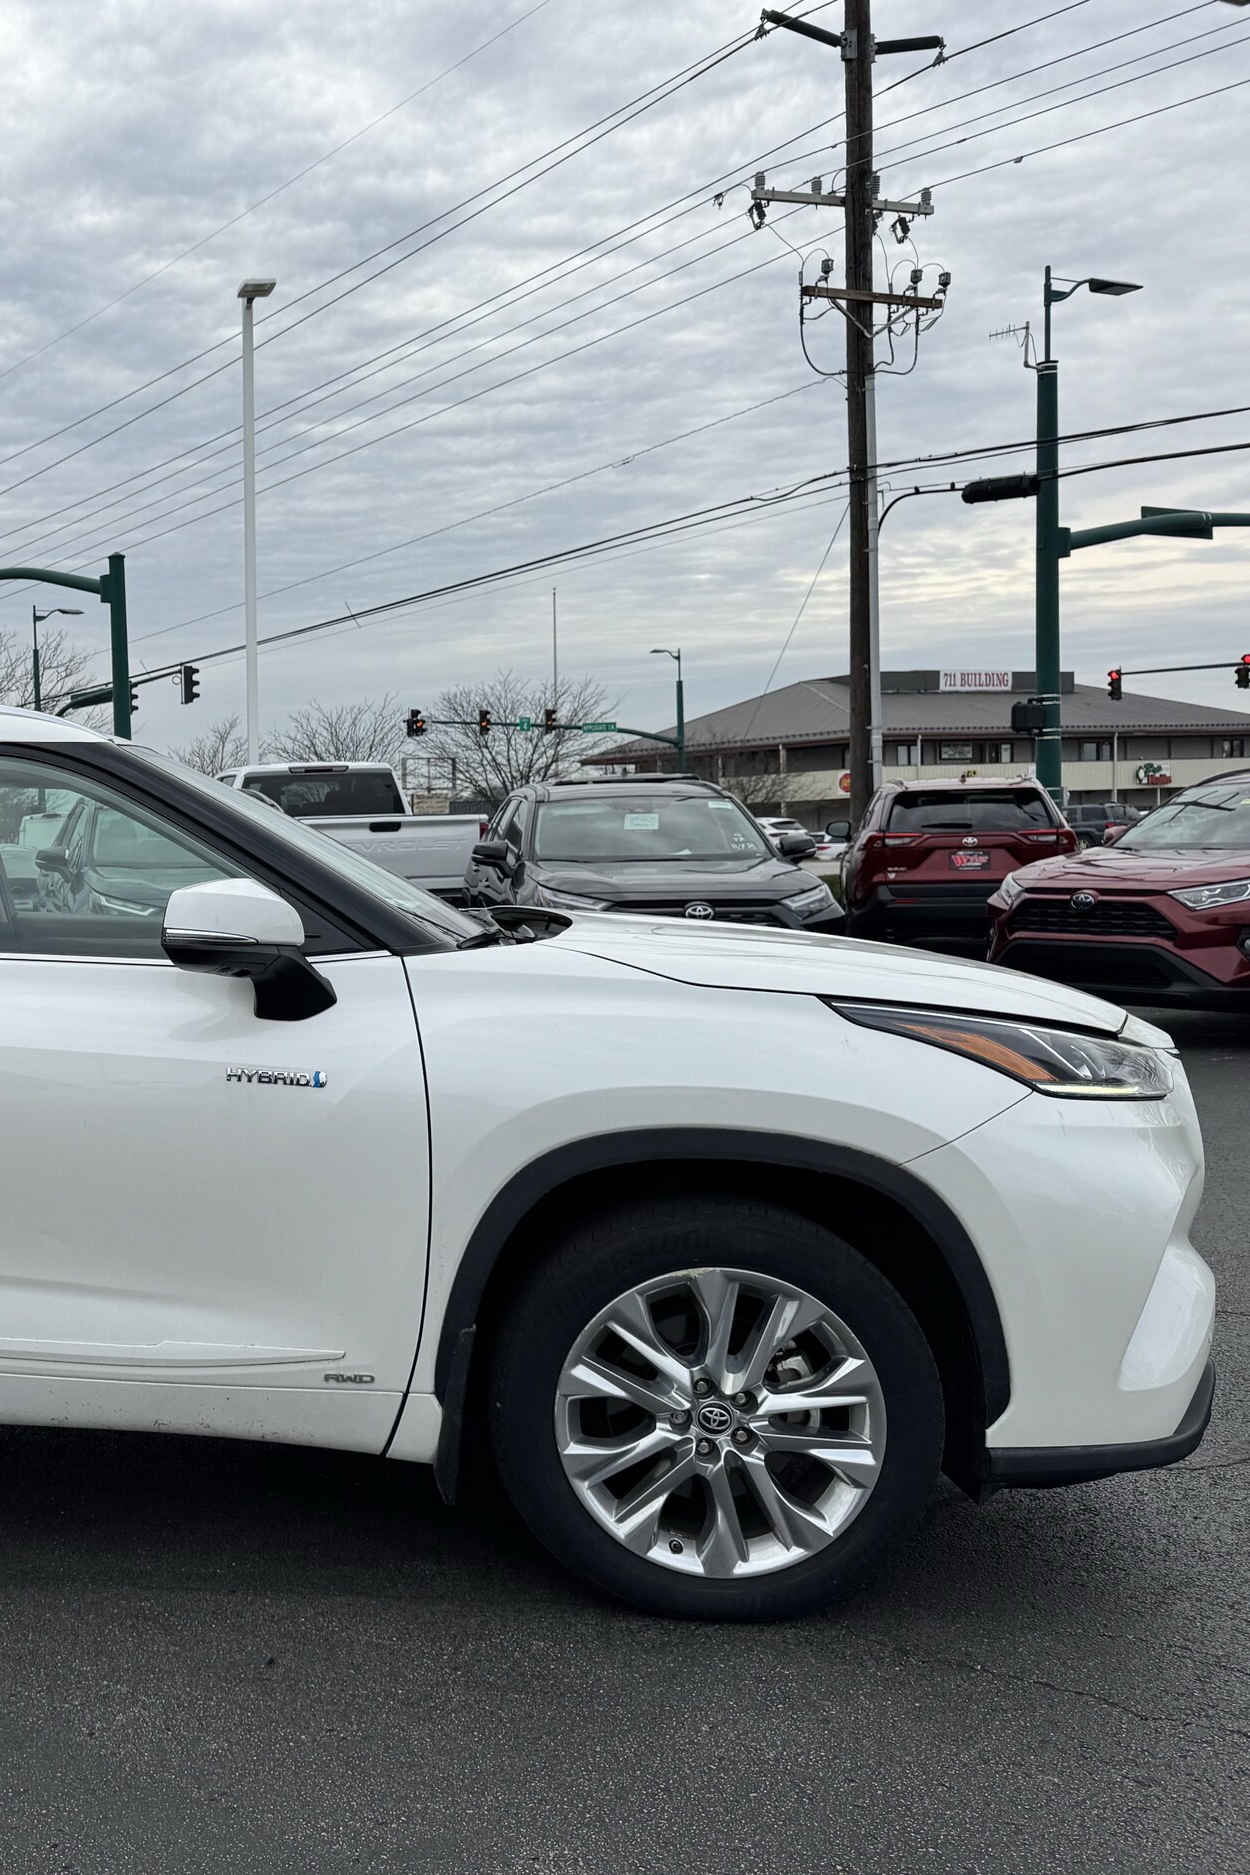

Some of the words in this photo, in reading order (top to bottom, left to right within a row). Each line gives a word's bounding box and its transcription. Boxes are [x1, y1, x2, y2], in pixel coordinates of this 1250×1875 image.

[943, 672, 957, 688] 711
[960, 672, 1009, 688] BUILDING
[225, 1067, 311, 1087] HYBRID
[323, 1373, 375, 1384] AWD
